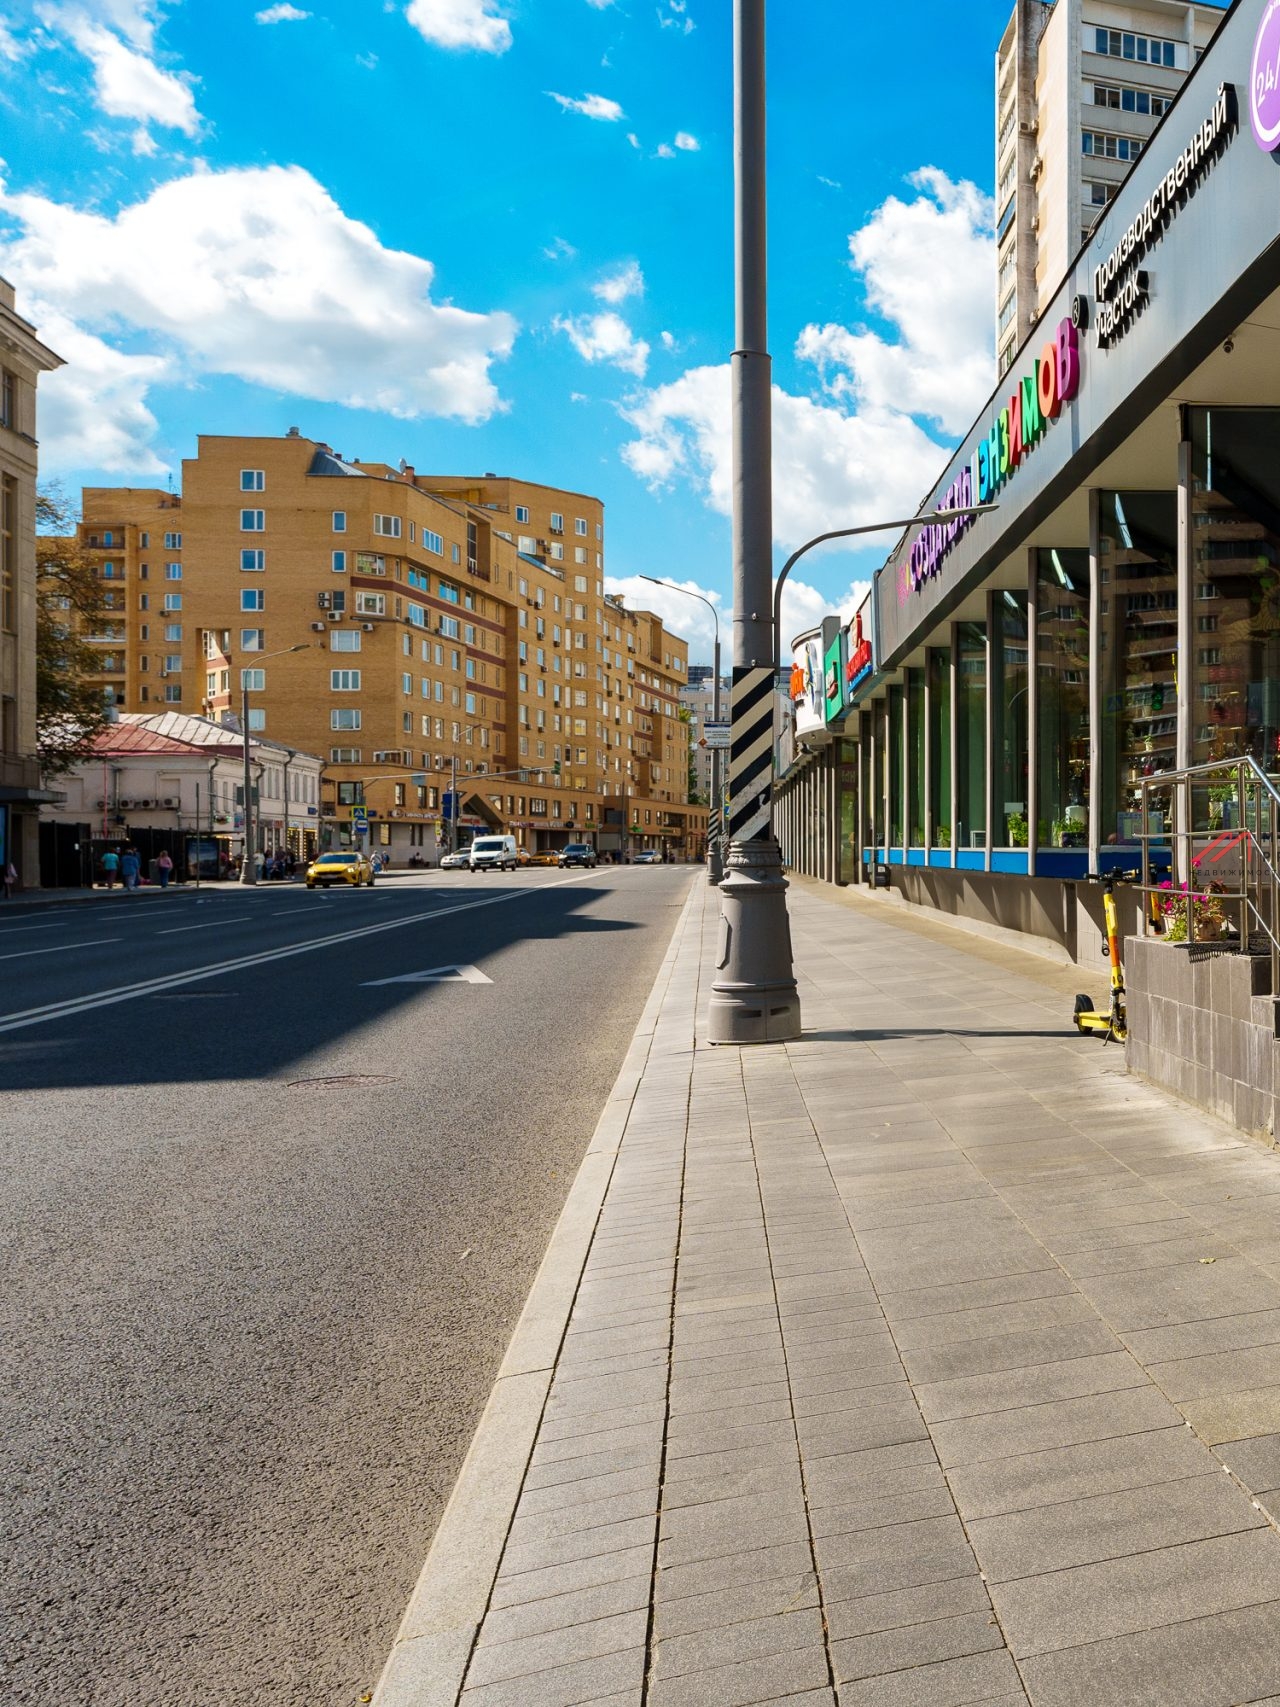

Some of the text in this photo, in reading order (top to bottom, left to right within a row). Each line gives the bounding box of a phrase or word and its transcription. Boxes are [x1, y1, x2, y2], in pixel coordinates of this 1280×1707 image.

[1093, 84, 1232, 300] Производственный
[1094, 273, 1143, 348] Участок
[979, 317, 1081, 502] ЭНЗИМОВ
